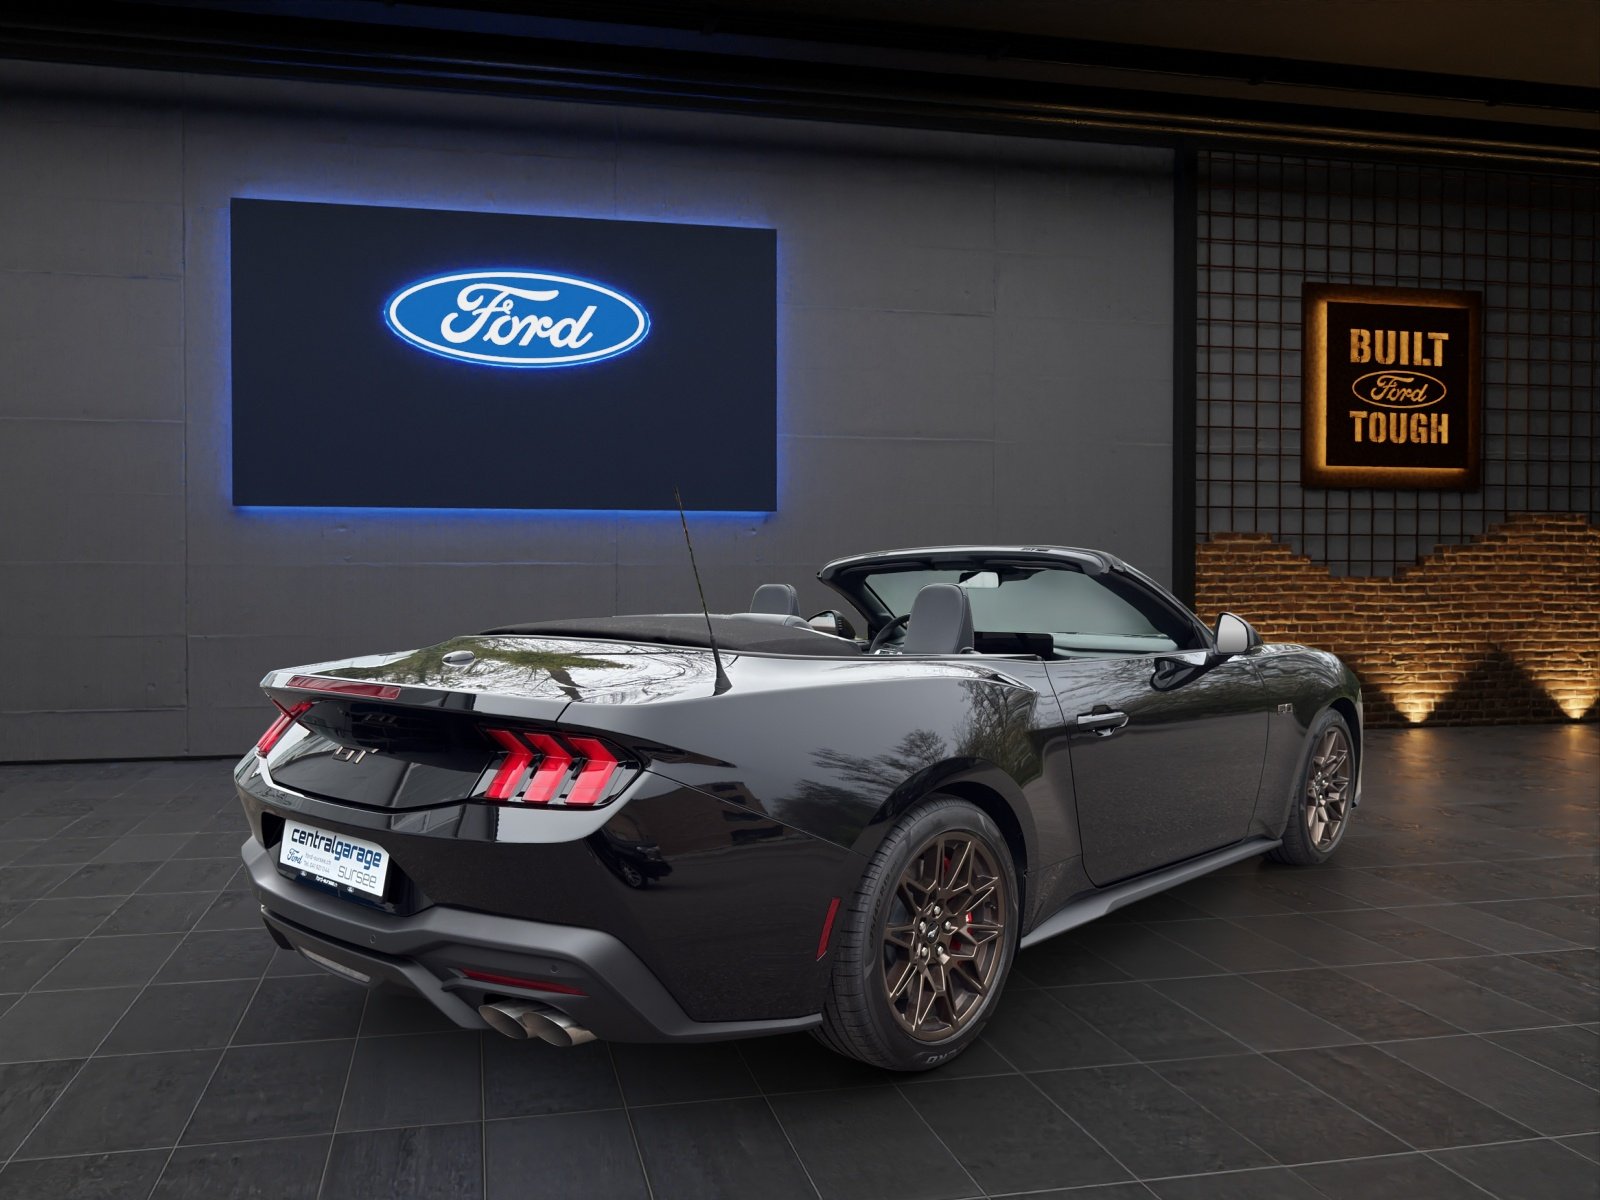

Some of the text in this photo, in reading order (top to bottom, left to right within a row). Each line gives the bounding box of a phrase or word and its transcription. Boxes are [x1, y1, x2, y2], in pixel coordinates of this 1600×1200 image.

[441, 283, 597, 348] Ford
[1350, 328, 1449, 367] BUILT
[1370, 374, 1428, 402] Ford
[1349, 411, 1449, 444] TOUGH
[332, 746, 379, 764] GT
[286, 848, 303, 864] Ford
[291, 828, 382, 870] centralgarage
[337, 865, 377, 889] sursee
